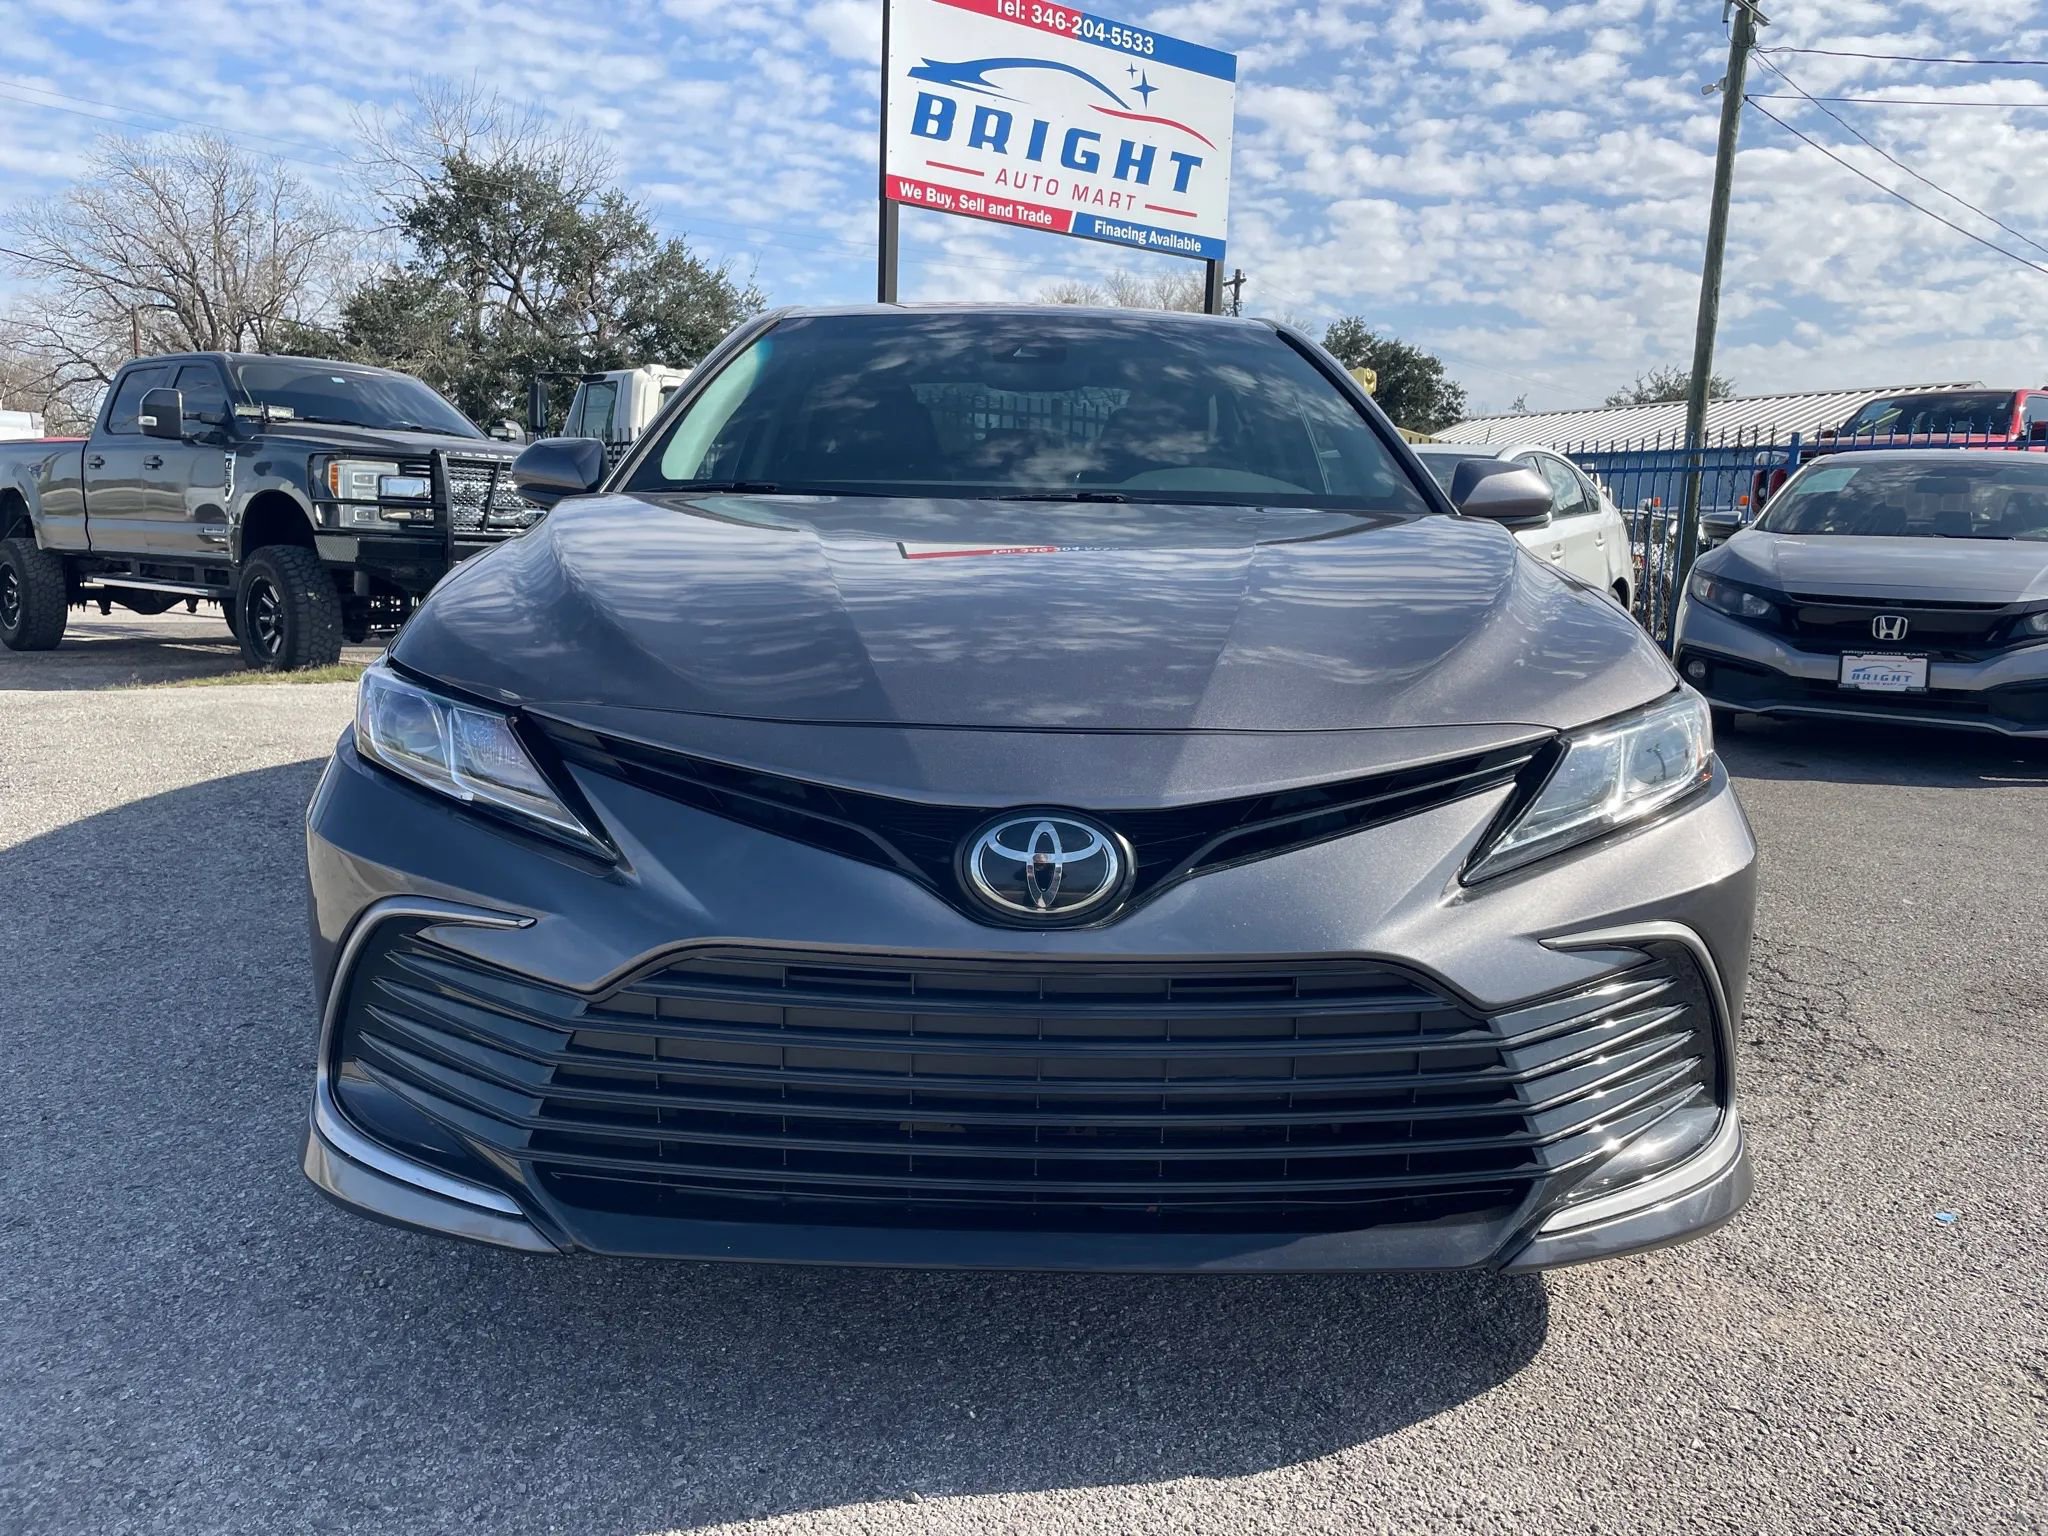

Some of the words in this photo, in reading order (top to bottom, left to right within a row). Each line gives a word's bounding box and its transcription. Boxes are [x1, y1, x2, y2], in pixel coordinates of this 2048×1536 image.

[996, 0, 1026, 20] Tel:
[1031, 4, 1154, 55] 346-204-5533
[910, 91, 1203, 194] BRIGHT
[899, 181, 923, 199] We
[926, 187, 956, 209] Buy,
[959, 194, 985, 213] Sell
[988, 203, 1013, 218] and
[1016, 205, 1053, 225] Trade
[994, 168, 1059, 196] AUTO
[1072, 183, 1137, 211] MART
[1094, 219, 1148, 245] Finacing
[1148, 230, 1202, 252] Available
[1851, 673, 1912, 683] BRIGHT
